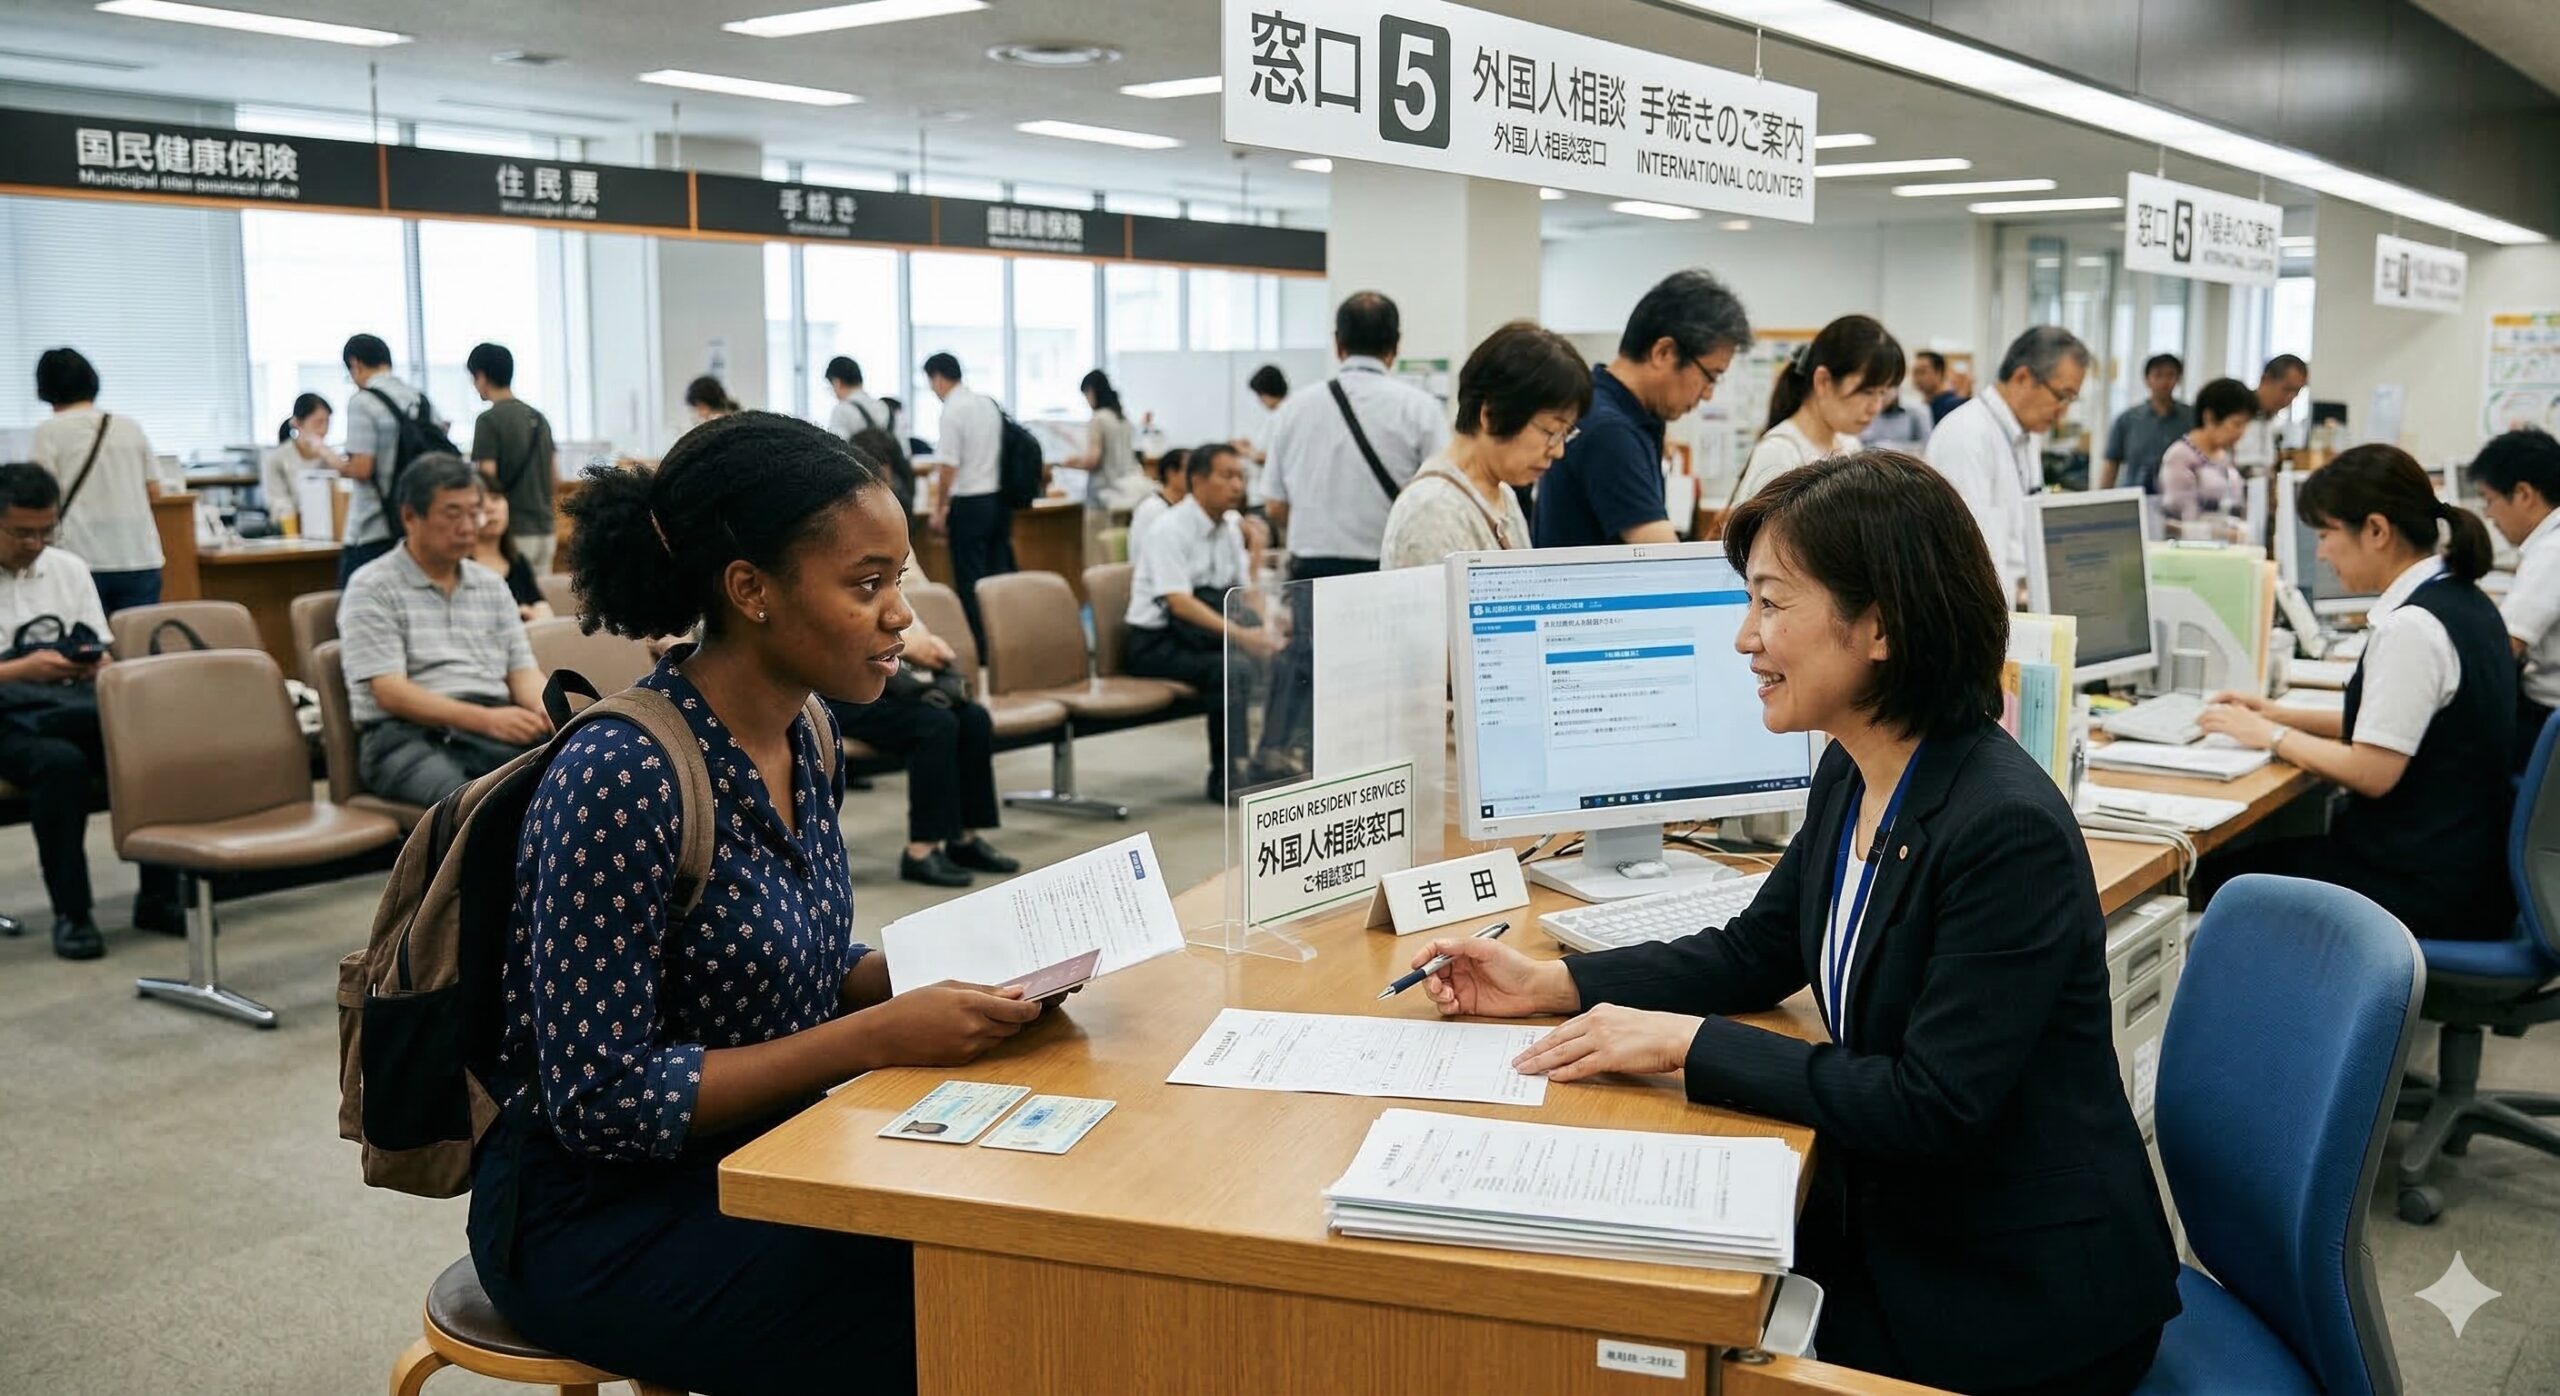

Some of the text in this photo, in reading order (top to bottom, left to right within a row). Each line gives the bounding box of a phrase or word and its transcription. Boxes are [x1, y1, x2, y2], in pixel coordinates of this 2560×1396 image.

[1250, 10, 1437, 131] 窓口 5
[1473, 45, 1804, 164] 外国人相談 手続きのご案内
[76, 127, 299, 181] 国民健康保険
[1494, 122, 1607, 167] 外国人相談窓口
[496, 164, 599, 204] 住民票
[1637, 149, 1803, 198] INTERNATIONAL COUNTER
[779, 188, 857, 224] 手続き
[2176, 203, 2190, 258] 5
[1257, 778, 1406, 830] FOREIGN RESIDENT SERVICES
[1258, 807, 1405, 878] 外国人相談窓口
